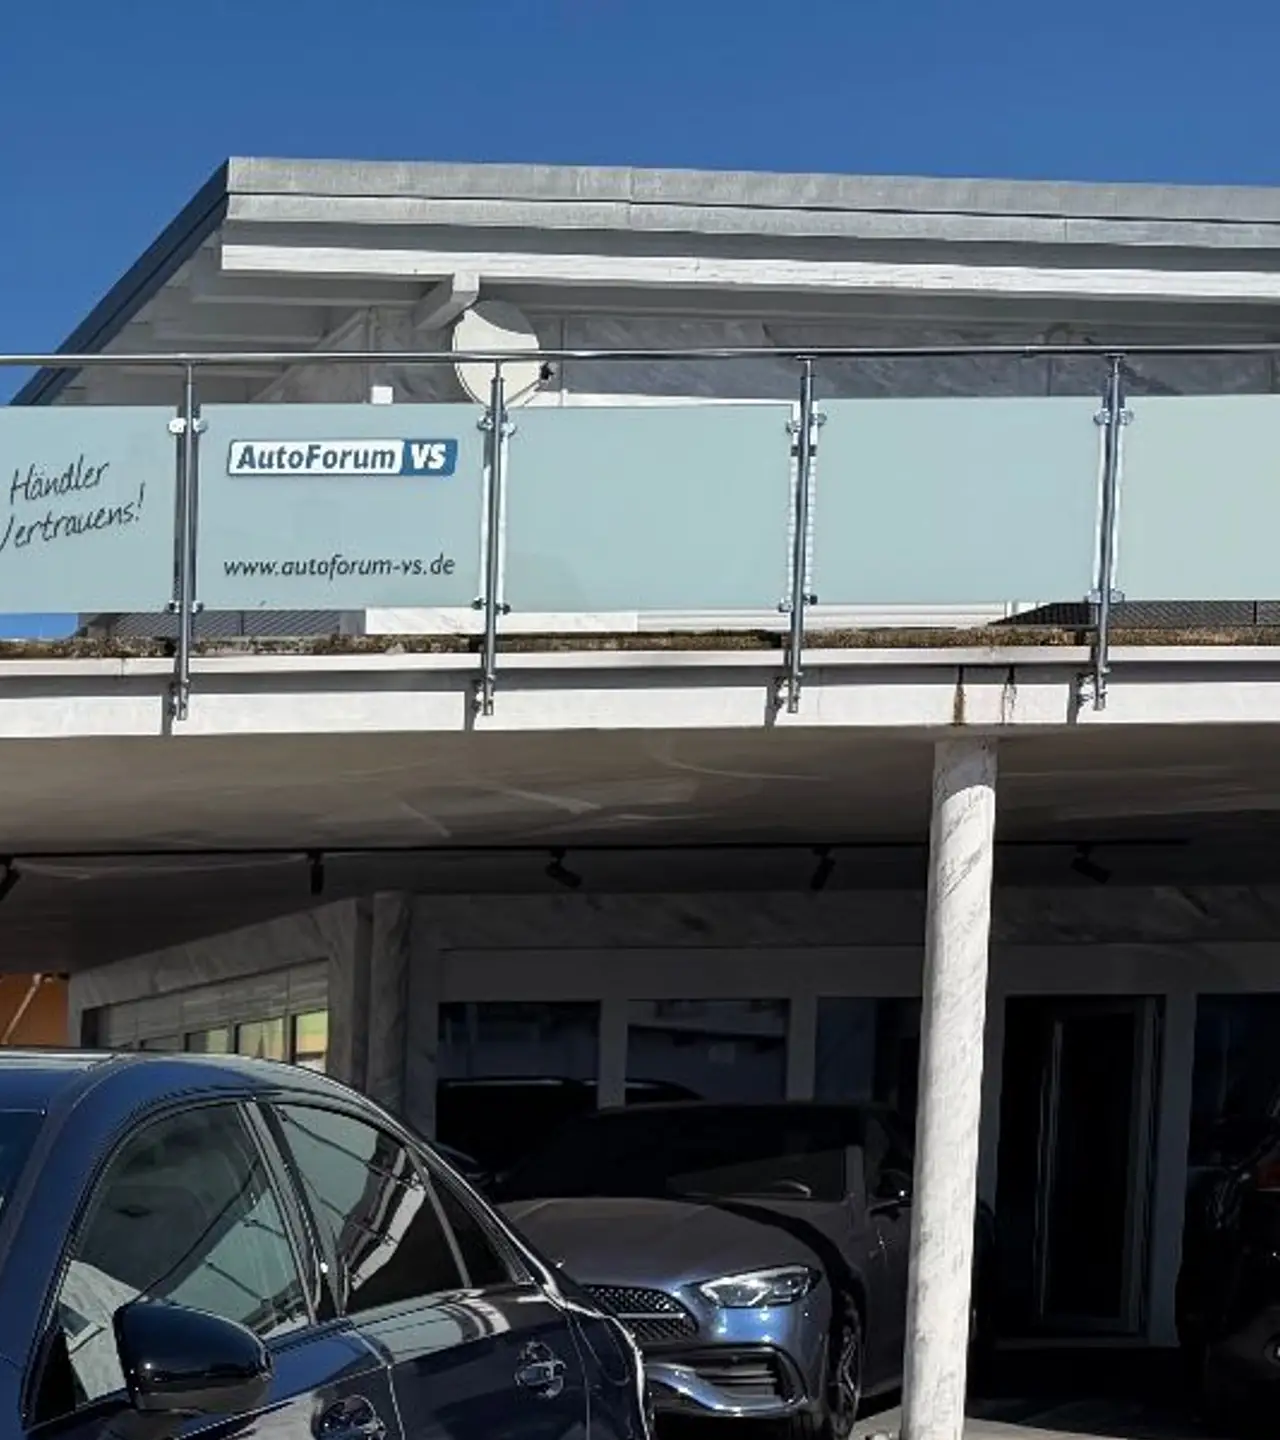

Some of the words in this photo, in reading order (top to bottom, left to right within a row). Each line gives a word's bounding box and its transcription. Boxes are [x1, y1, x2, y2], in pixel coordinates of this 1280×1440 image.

[237, 444, 396, 470] AutoForum
[412, 443, 447, 470] VS
[10, 453, 110, 505] Händler
[224, 552, 455, 580] www.autoforum-vs.de
